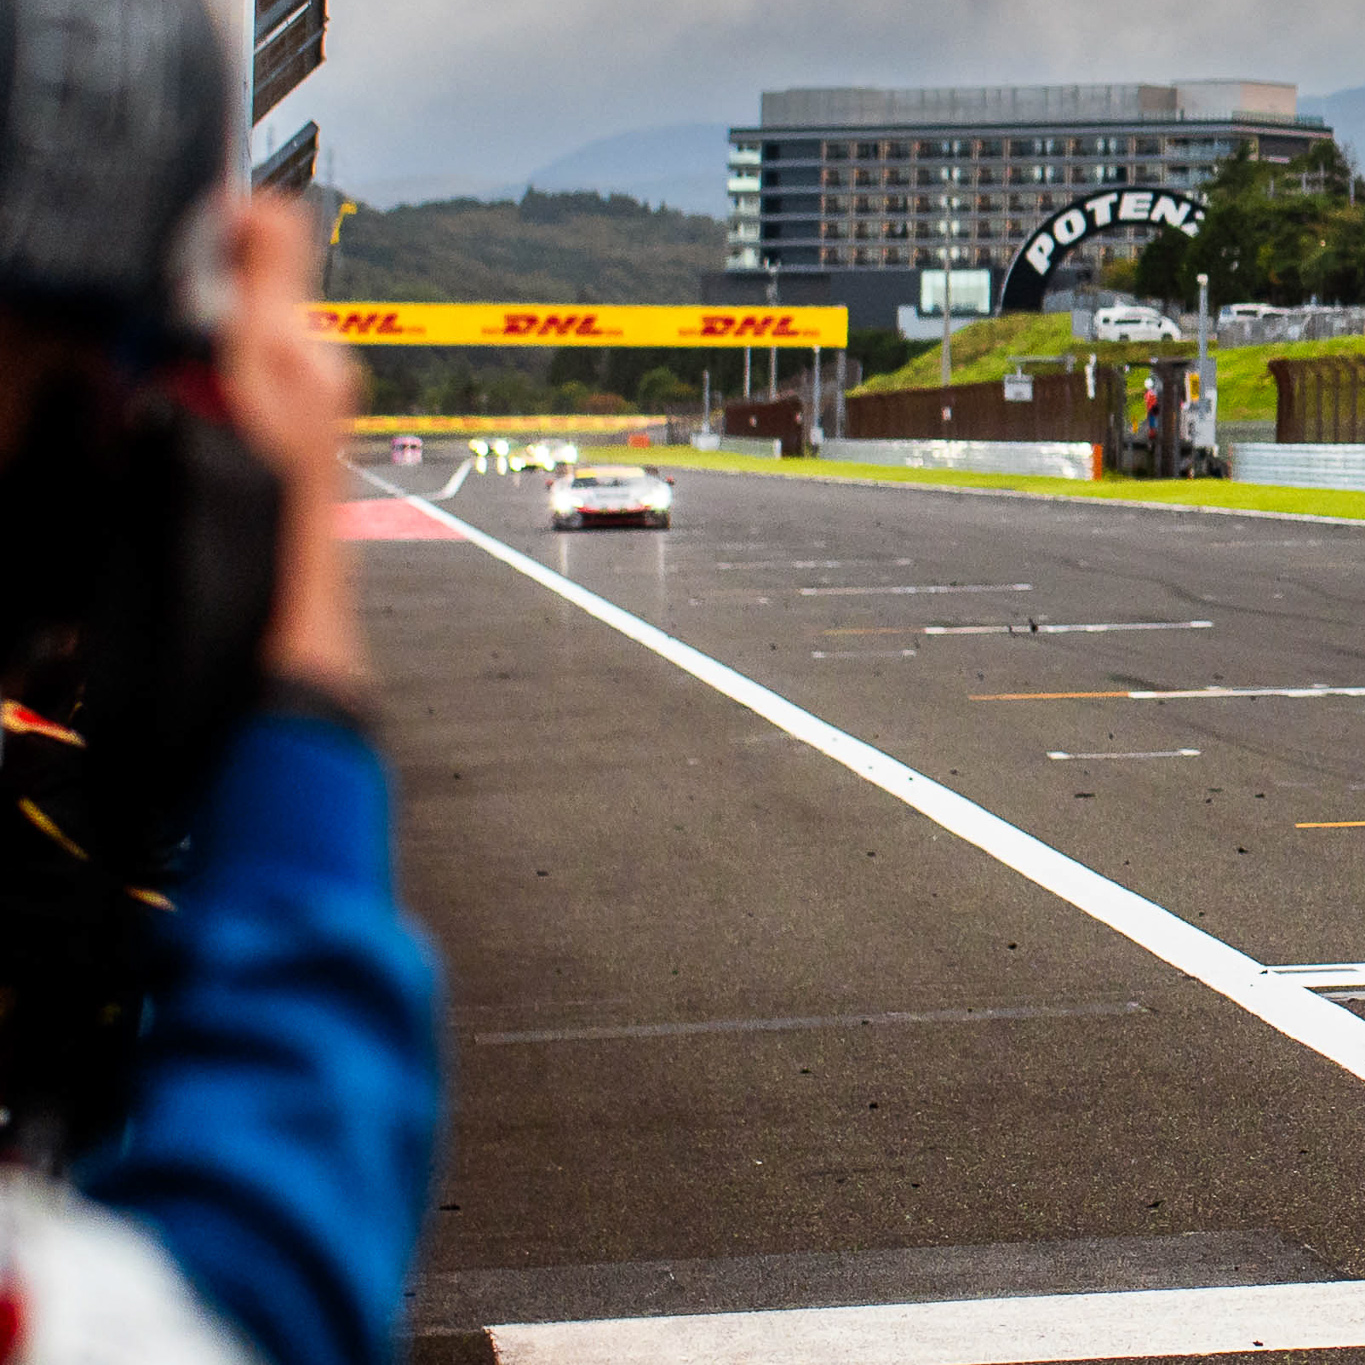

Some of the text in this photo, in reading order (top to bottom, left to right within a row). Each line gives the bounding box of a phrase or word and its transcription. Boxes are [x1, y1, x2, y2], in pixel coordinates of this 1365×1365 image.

[308, 311, 402, 334] DHL
[503, 313, 602, 336] DHL
[701, 315, 799, 337] DHL
